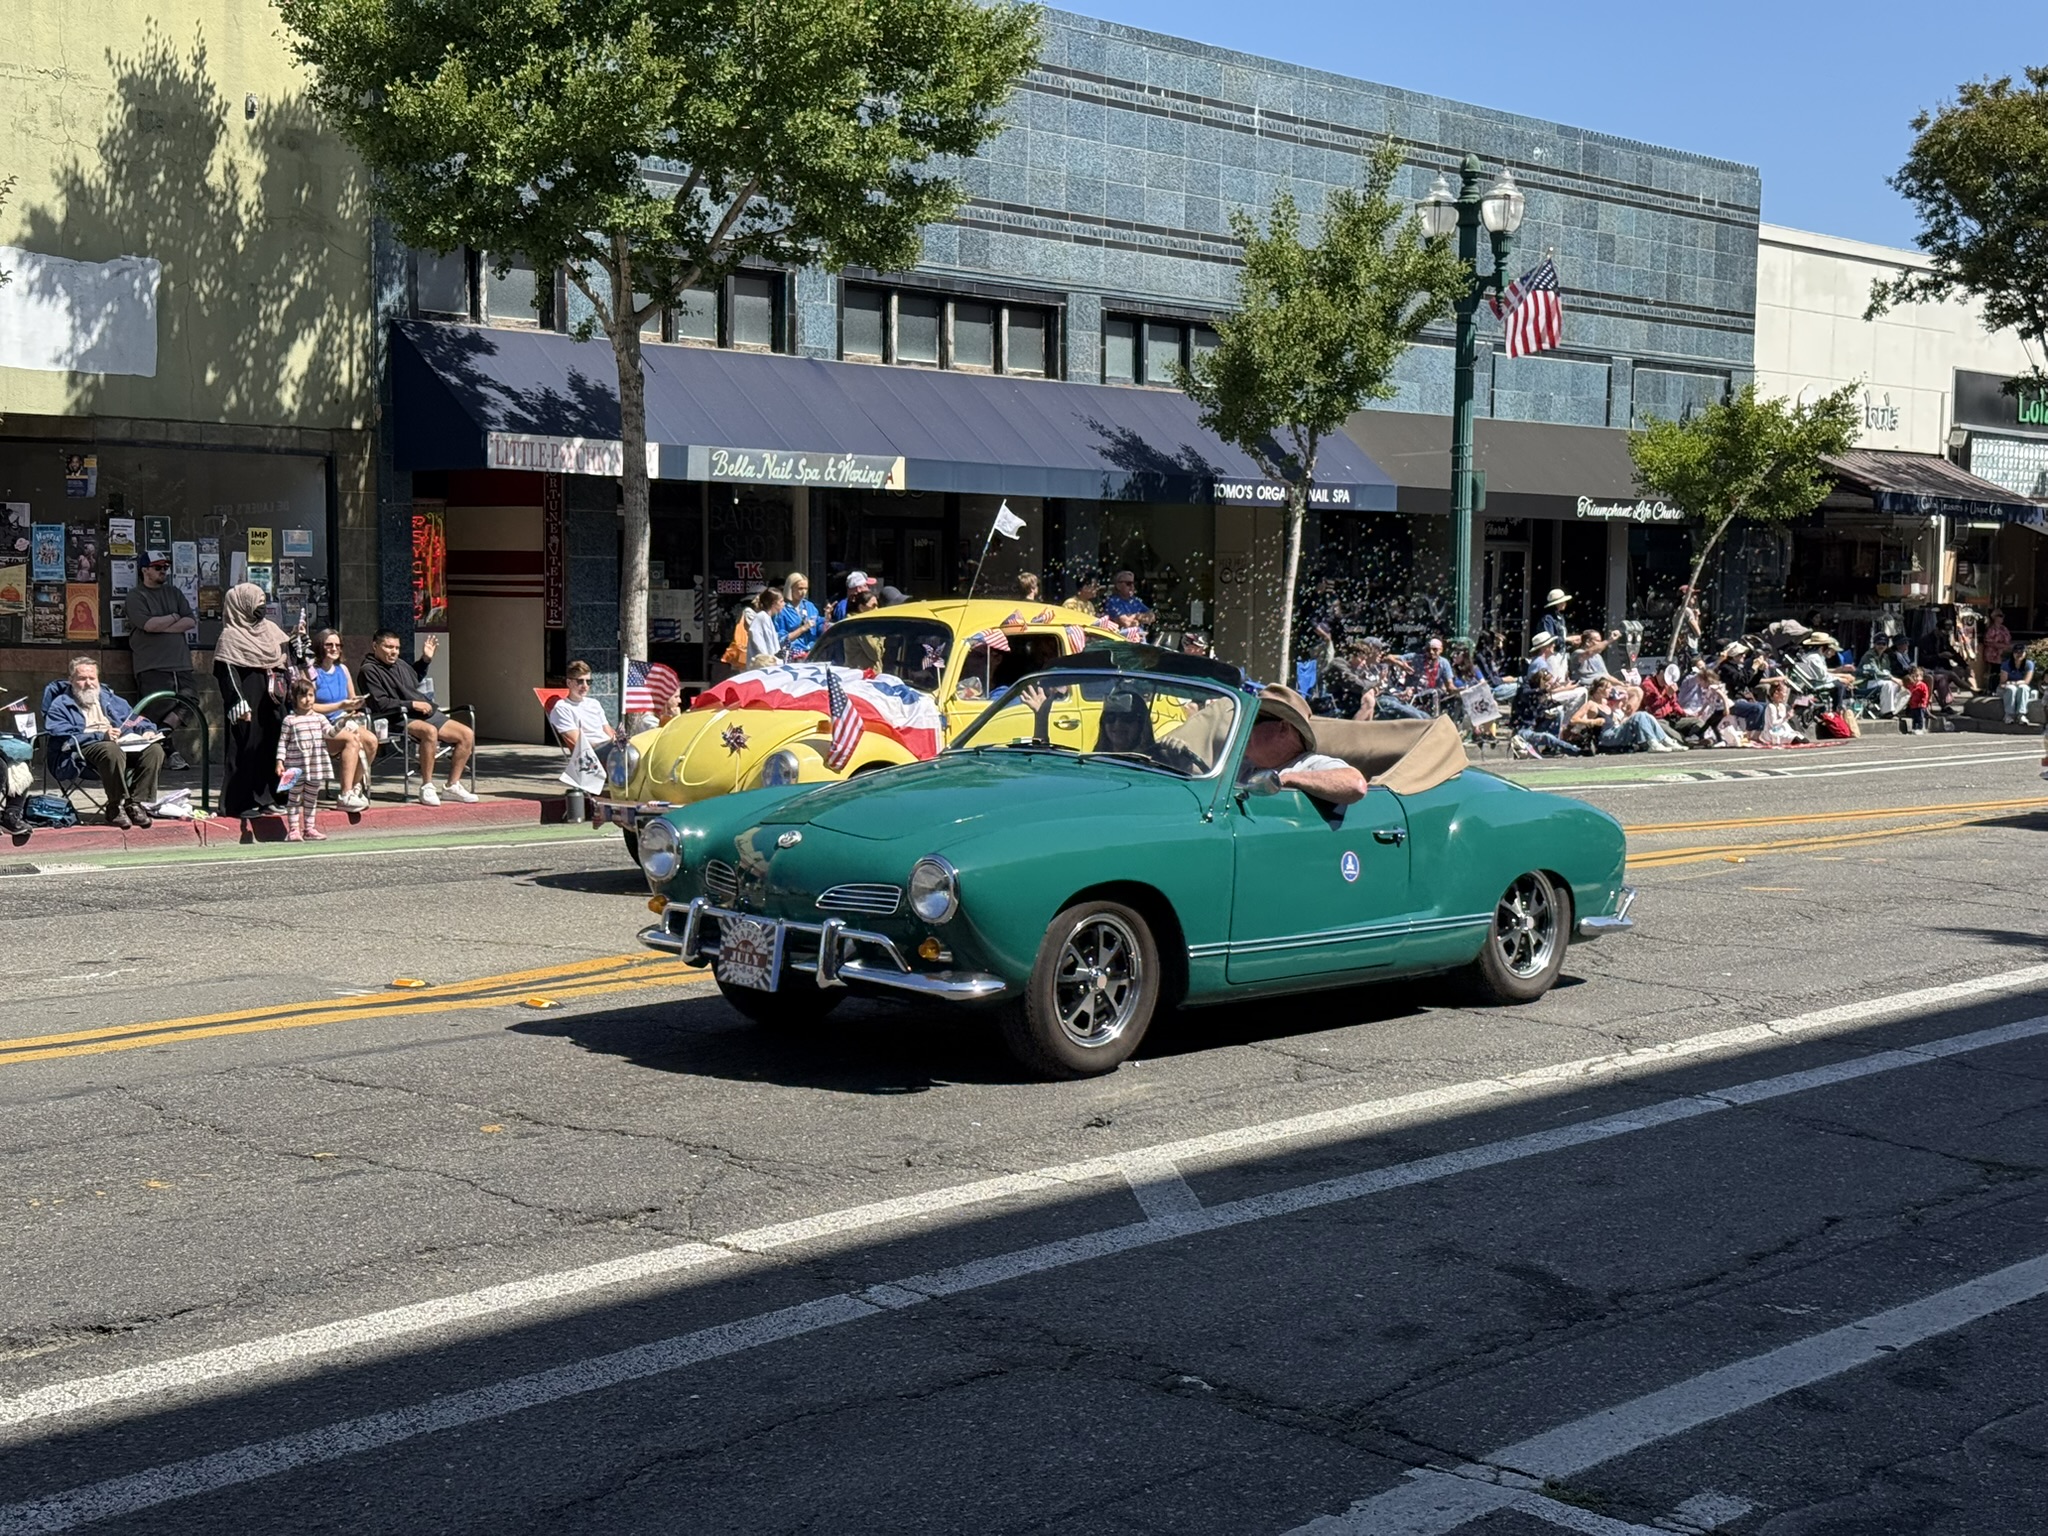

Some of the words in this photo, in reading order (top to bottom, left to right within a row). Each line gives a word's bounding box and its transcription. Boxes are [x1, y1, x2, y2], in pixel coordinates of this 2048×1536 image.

[712, 450, 756, 477] Bella
[757, 453, 792, 479] Nail
[795, 458, 821, 486] Spa
[824, 457, 837, 482] &
[838, 460, 885, 488] Waxing
[1213, 484, 1253, 499] TOMO'S
[1257, 486, 1289, 501] ORGA
[1308, 488, 1329, 503] NAIL
[1332, 489, 1350, 503] SPA
[1577, 496, 1633, 520] Triumphant
[1633, 500, 1651, 523] Life
[1653, 501, 1685, 520] Church
[251, 531, 268, 539] IMP
[734, 561, 763, 579] TK
[549, 556, 559, 618] TELLER
[729, 950, 761, 966] JULY
